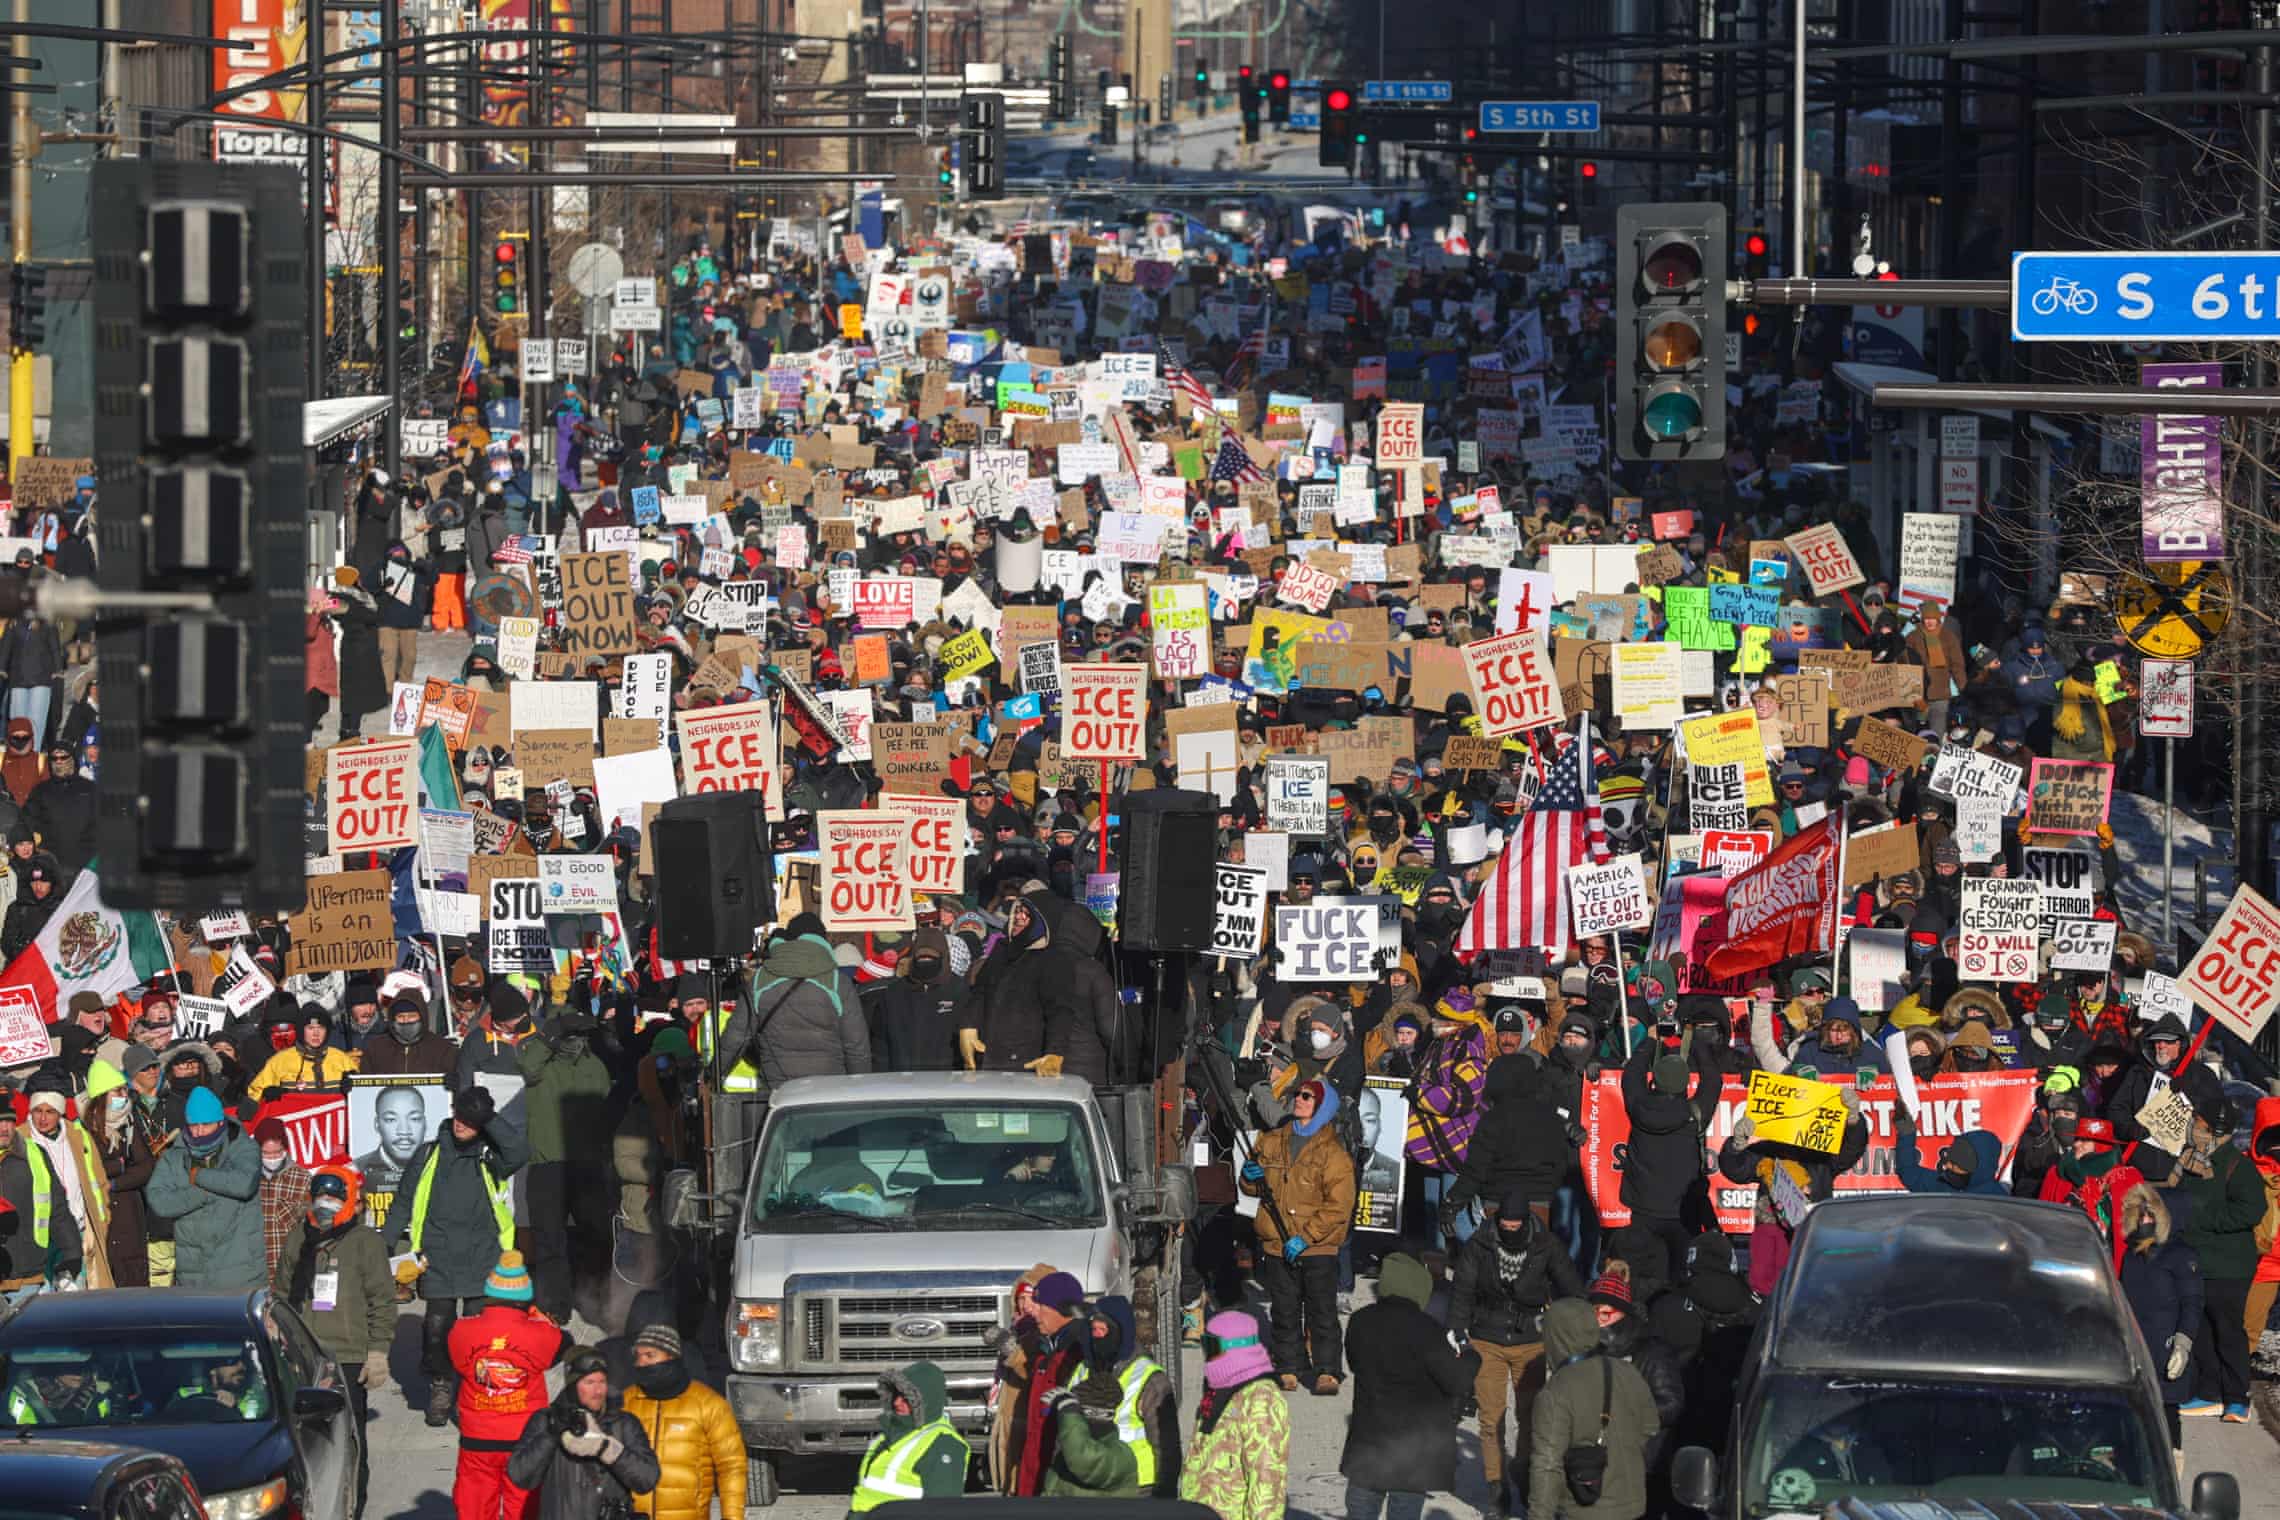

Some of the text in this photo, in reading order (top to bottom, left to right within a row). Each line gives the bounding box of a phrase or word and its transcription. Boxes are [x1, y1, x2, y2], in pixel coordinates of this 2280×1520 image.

[1489, 108, 1590, 125] S 5th St
[2117, 272, 2280, 320] S 6t
[526, 343, 547, 354] ONE
[526, 356, 549, 365] WAY
[1103, 357, 1134, 373] ICE
[1382, 419, 1417, 438] ICE
[1380, 440, 1417, 457] OUT!
[975, 449, 1026, 474] Purple
[1951, 466, 1968, 479] NO
[1800, 541, 1844, 565] ICE
[565, 555, 628, 589] ICE
[1812, 560, 1855, 583] OUT!
[855, 583, 913, 603] LOVE
[1313, 574, 1335, 593] GO
[722, 583, 766, 607] STOP
[1281, 582, 1328, 610] HOME
[566, 592, 628, 622] OUT
[567, 623, 633, 653] NOW
[956, 636, 977, 654] OUT
[1154, 645, 1197, 661] CACA
[1471, 643, 1516, 660] NEIGHBORS
[1516, 637, 1536, 648] SAY
[1072, 675, 1139, 685] NEIGHBORS SAY
[1476, 650, 1542, 692] ICE
[2156, 671, 2177, 686] NO
[1025, 675, 1059, 690] MURDER
[1779, 678, 1823, 703] GET
[1072, 688, 1135, 720] ICE
[1486, 684, 1551, 725] OUT!
[1781, 703, 1814, 721] TF
[687, 719, 762, 738] NEIGHBORS SAY
[879, 727, 904, 739] LOW
[1072, 721, 1140, 754] OUT!
[1270, 727, 1305, 747] FUCK
[1782, 722, 1820, 744] OUT
[335, 752, 409, 770] NEIGHBORS SAY
[690, 734, 763, 773] ICE
[336, 766, 405, 804] ICE
[1693, 765, 1738, 785] KILLER
[1283, 780, 1313, 798] ICE
[1691, 783, 1744, 802] ICE
[2051, 783, 2104, 800] FUCK
[1691, 802, 1745, 813] OFF OUR
[336, 804, 409, 841] OUT!
[1691, 811, 1746, 830] STREETS
[1968, 822, 1988, 833] YOU
[830, 828, 904, 840] NEIGHBORS SAY
[911, 818, 954, 853] CE
[569, 863, 605, 874] GOOD
[830, 842, 897, 876] ICE
[909, 856, 957, 887] UT!
[1574, 865, 1635, 888] AMERICA
[2026, 850, 2090, 889] STOP
[571, 886, 598, 897] EVIL
[1581, 882, 1628, 902] YELLS
[1963, 880, 2039, 894] MY GRANDPA
[492, 881, 543, 921] STO
[830, 880, 903, 915] OUT!
[1579, 894, 1640, 918] ICE OUT
[1979, 895, 2034, 911] FOUGHT
[2046, 895, 2090, 913] TERROR
[309, 912, 372, 934] is an
[1228, 914, 1256, 931] MN
[1278, 907, 1367, 941] FUCK
[1580, 910, 1643, 933] FOR GOOD
[1962, 911, 2038, 930] GESTAPO
[2058, 922, 2097, 939] ICE
[492, 928, 510, 946] ICE
[1962, 935, 2036, 952] SO WILL
[492, 946, 551, 960] NOW
[2055, 939, 2110, 956] OUT!
[2217, 917, 2280, 988] ICE
[1295, 942, 1370, 975] ICE
[1989, 951, 2005, 977] I
[2196, 951, 2273, 1018] OUT!
[1750, 1074, 1808, 1101] Fuera
[1931, 1080, 1967, 1091] Housing
[1751, 1099, 1786, 1115] ICE
[1814, 1108, 1843, 1122] ICE
[2156, 1108, 2183, 1137] DUDE
[1794, 1131, 1834, 1151] NOW
